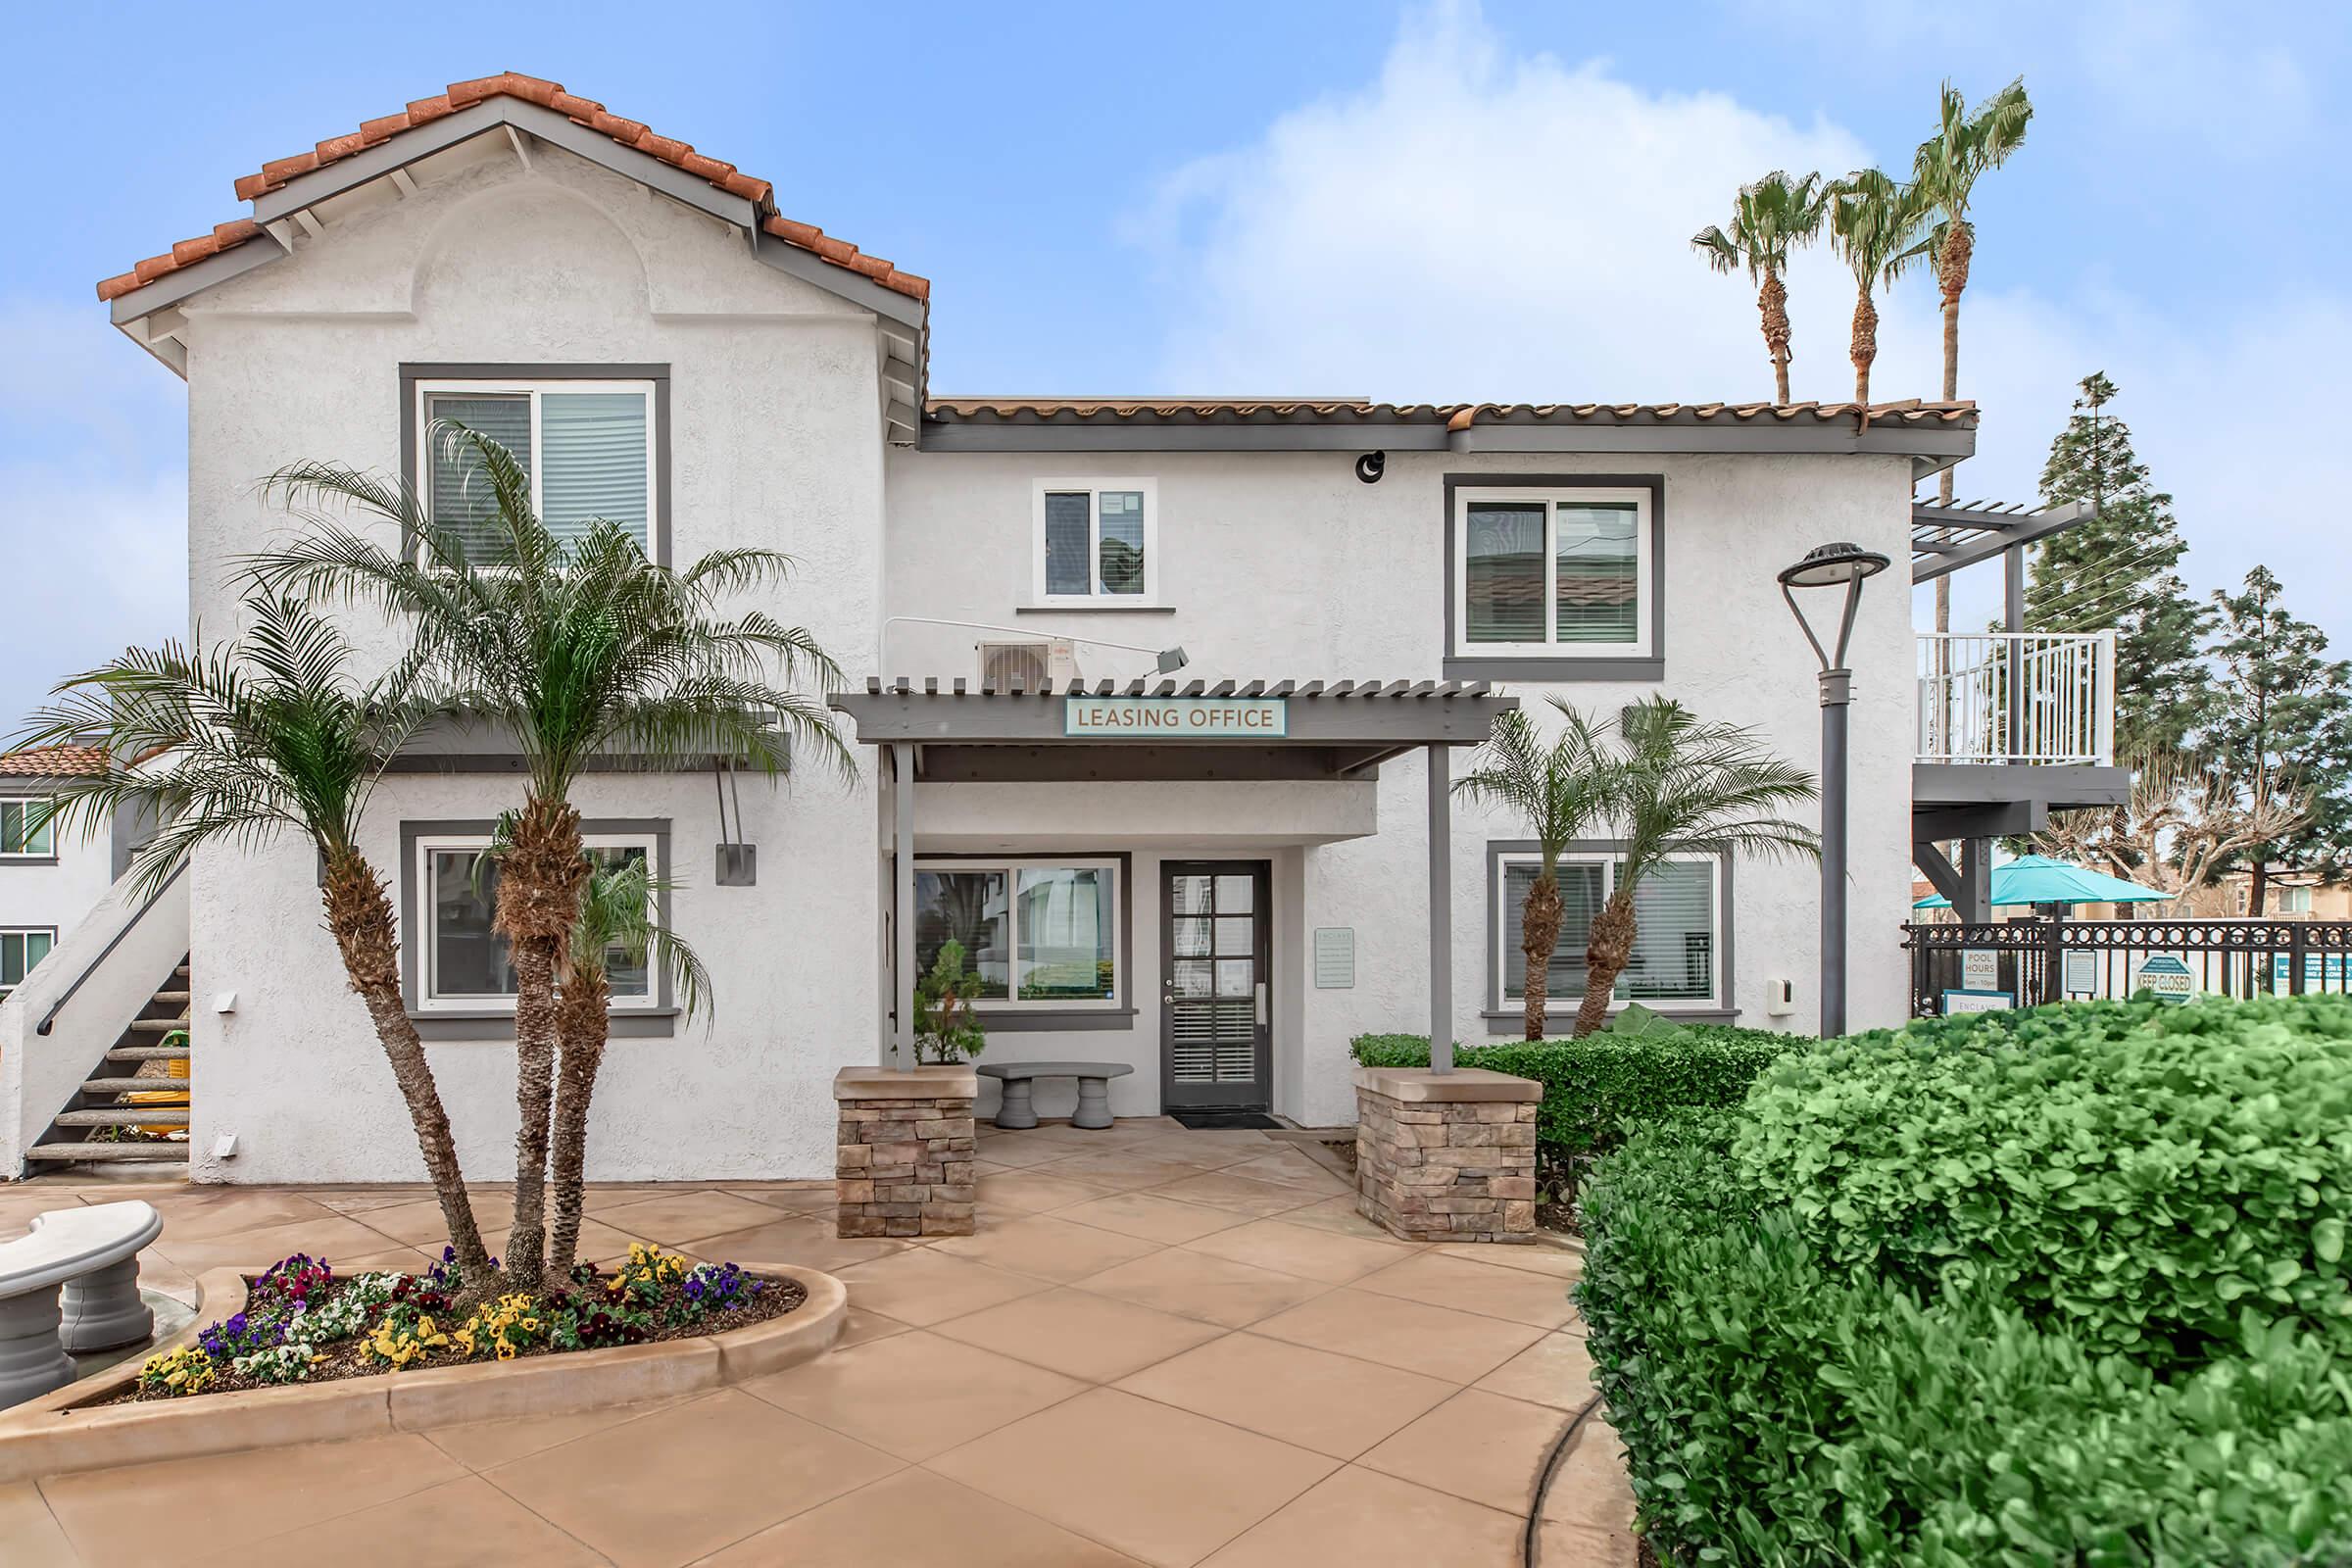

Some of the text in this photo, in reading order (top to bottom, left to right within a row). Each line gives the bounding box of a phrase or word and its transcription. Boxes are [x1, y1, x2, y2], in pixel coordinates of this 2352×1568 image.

[1078, 709, 1273, 727] LEASING OFFICE
[1968, 954, 1992, 962] POOL
[1966, 964, 1995, 973] HOURS
[2137, 974, 2191, 992] KEEP CLOSED
